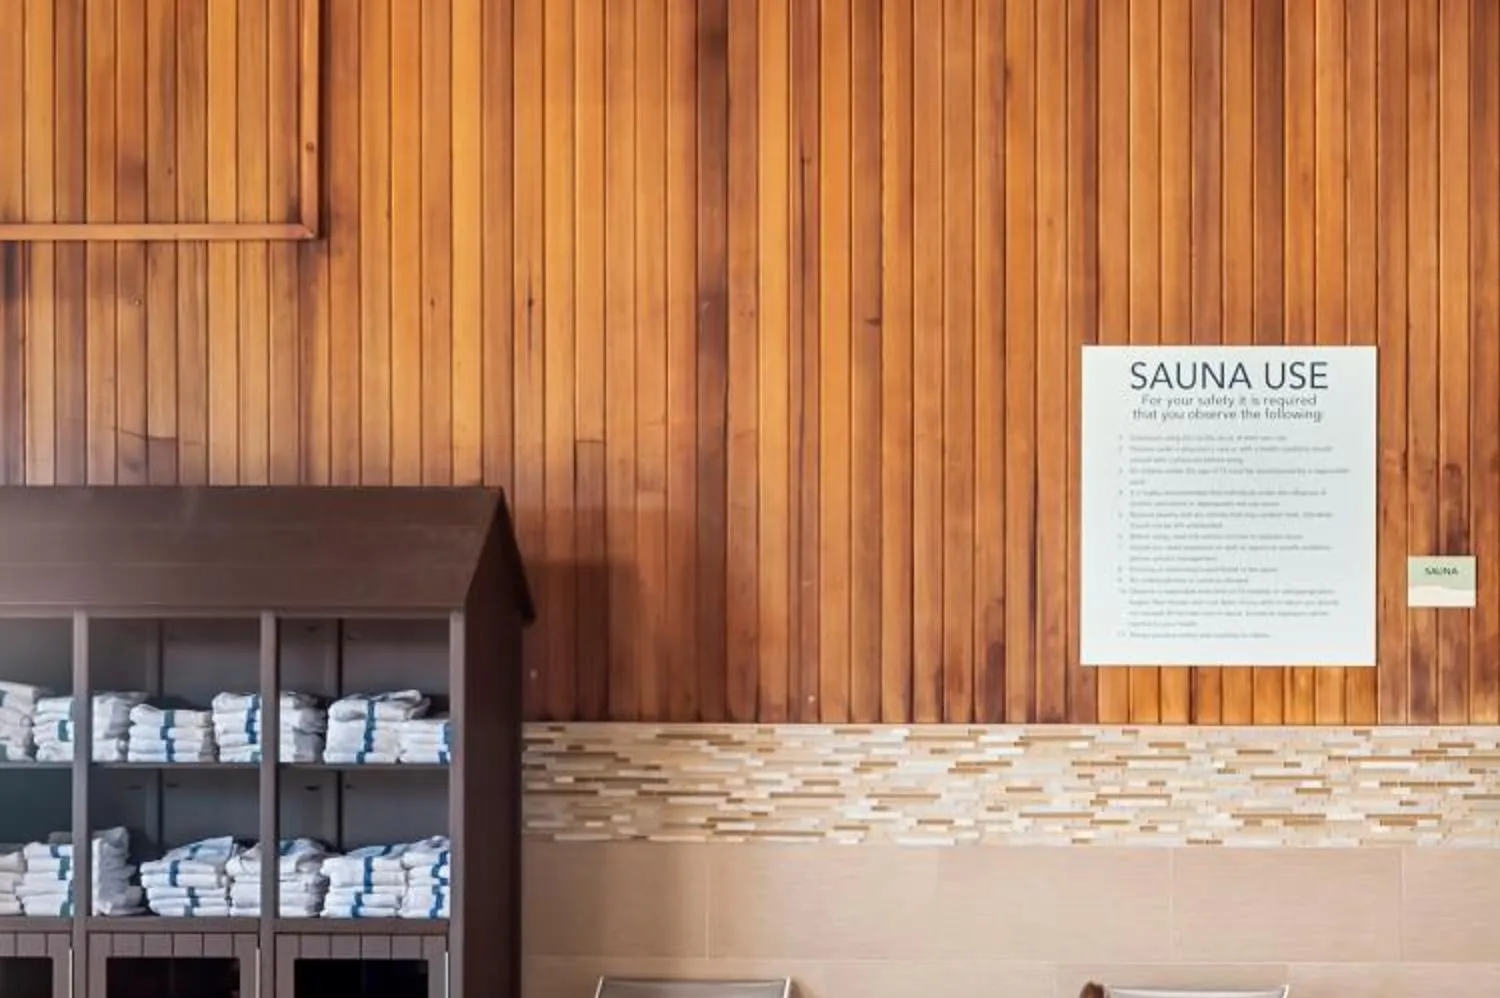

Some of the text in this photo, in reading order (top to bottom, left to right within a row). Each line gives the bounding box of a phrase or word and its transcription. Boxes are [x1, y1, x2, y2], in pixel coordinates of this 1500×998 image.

[1130, 361, 1329, 390] SAUNA USE
[1141, 394, 1162, 405] For
[1166, 396, 1194, 408] your
[1197, 394, 1234, 408] safety
[1264, 394, 1317, 408] required
[1133, 407, 1157, 419] that
[1161, 410, 1185, 422] you
[1188, 407, 1237, 419] observe
[1241, 407, 1262, 419] the
